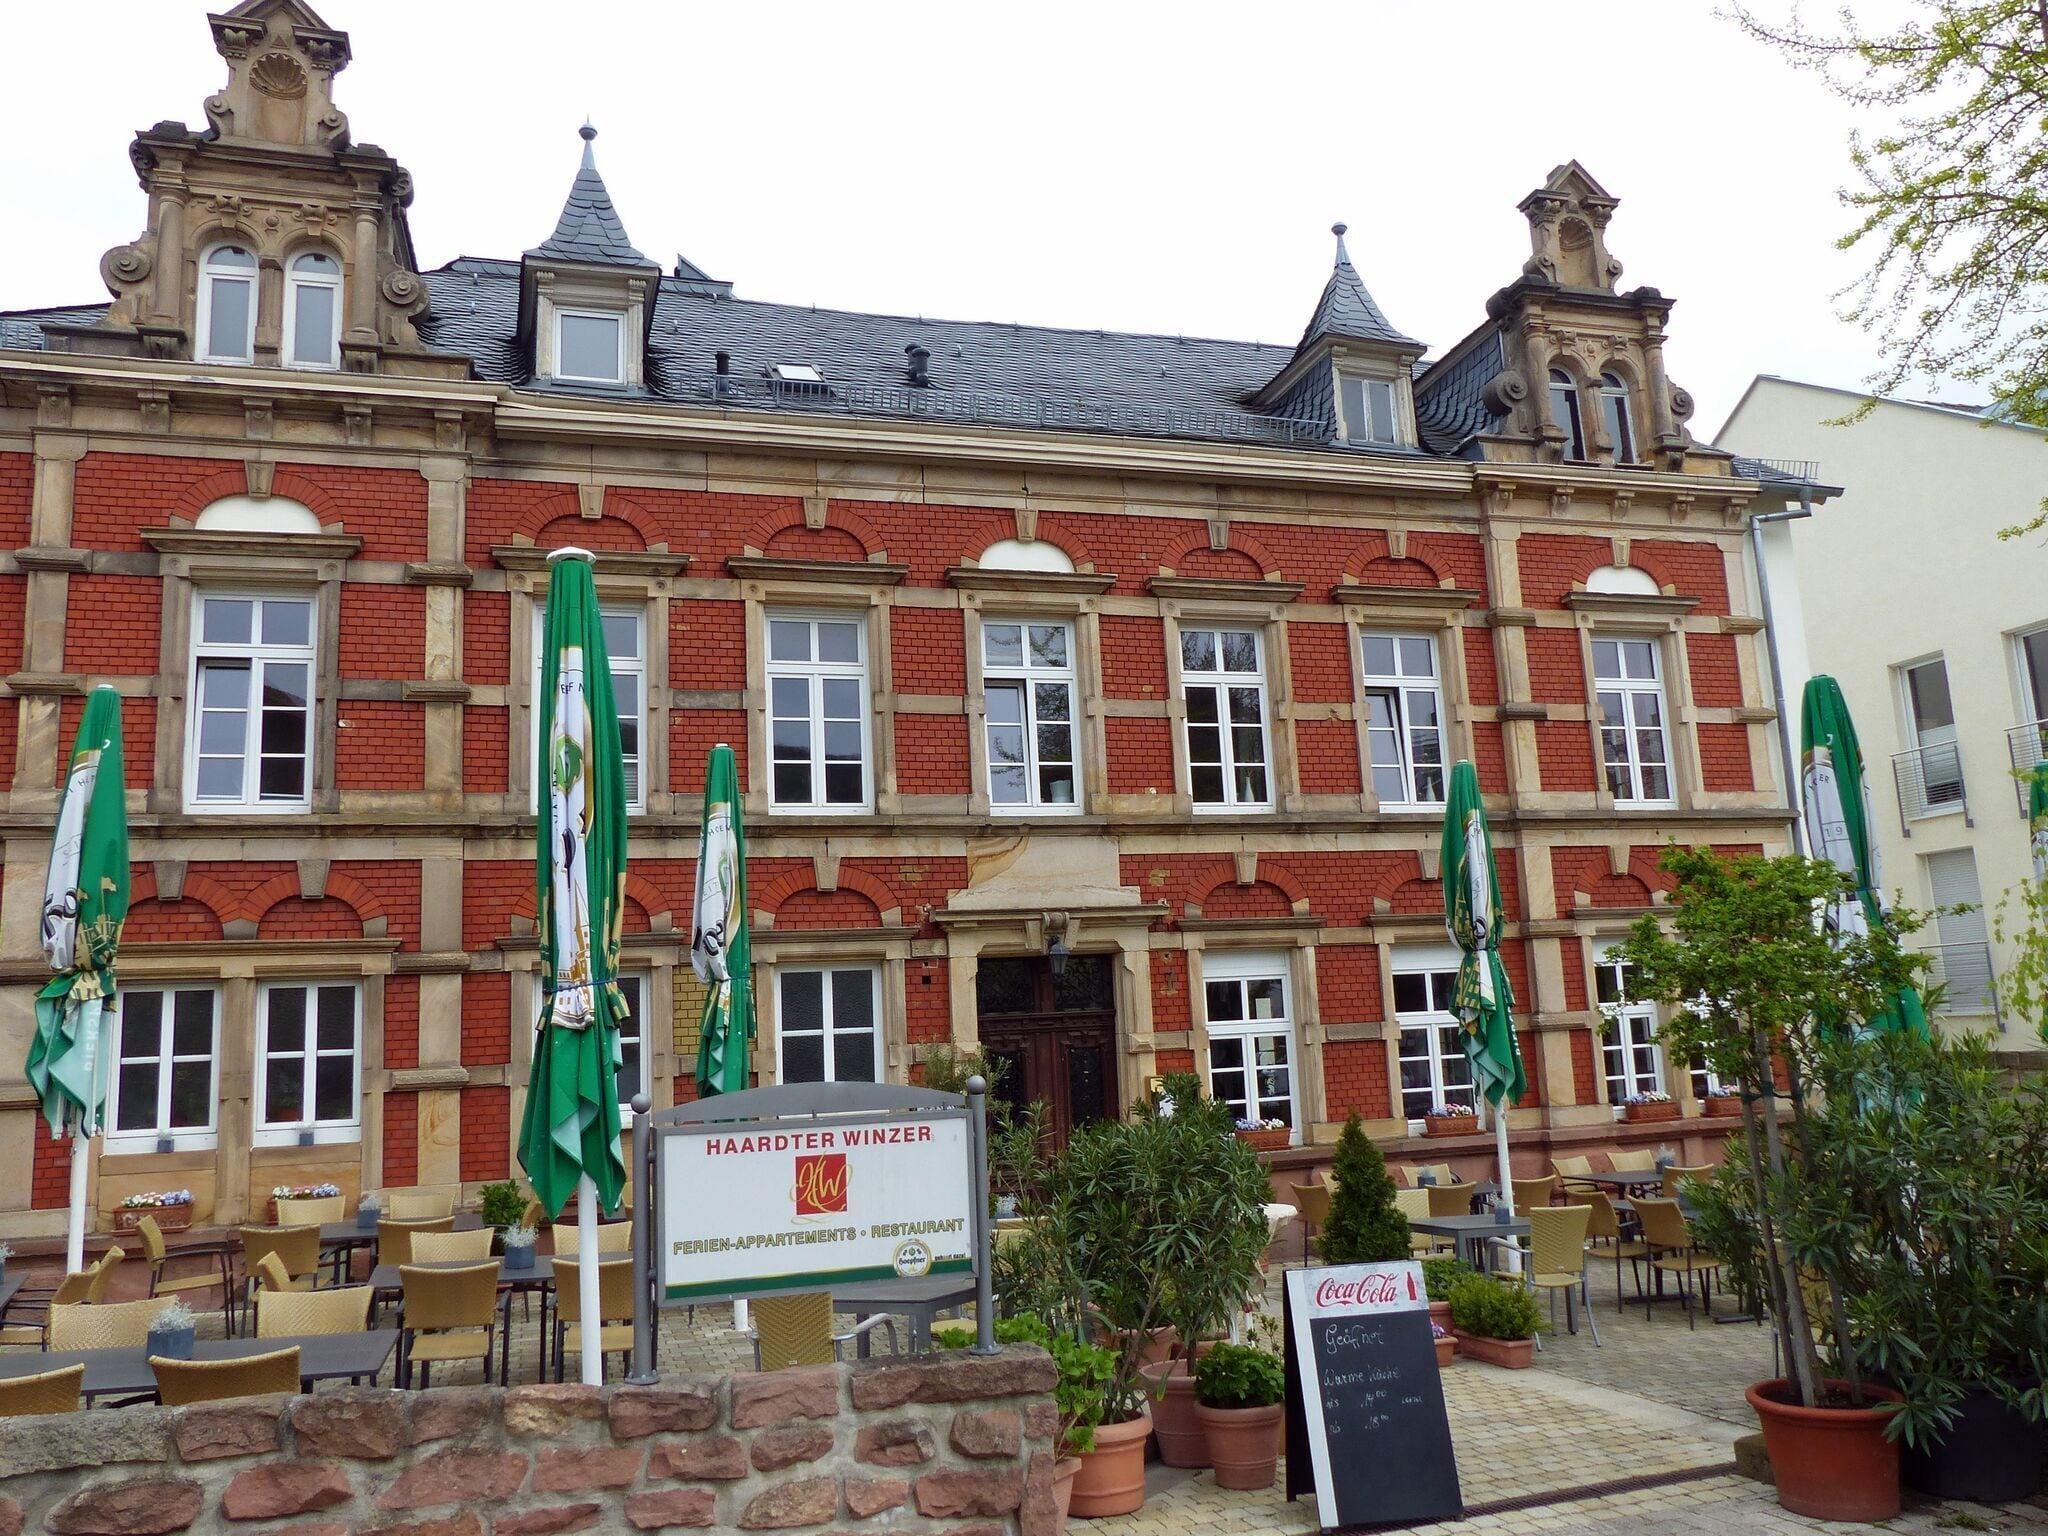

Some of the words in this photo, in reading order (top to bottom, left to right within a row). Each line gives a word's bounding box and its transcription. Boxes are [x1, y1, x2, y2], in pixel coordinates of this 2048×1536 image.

[706, 1132, 834, 1155] HAARDTER
[843, 1126, 932, 1147] WINZER
[673, 1227, 857, 1255] FERIEN-APPARTEMENTS
[871, 1218, 965, 1238] RESTAURANT
